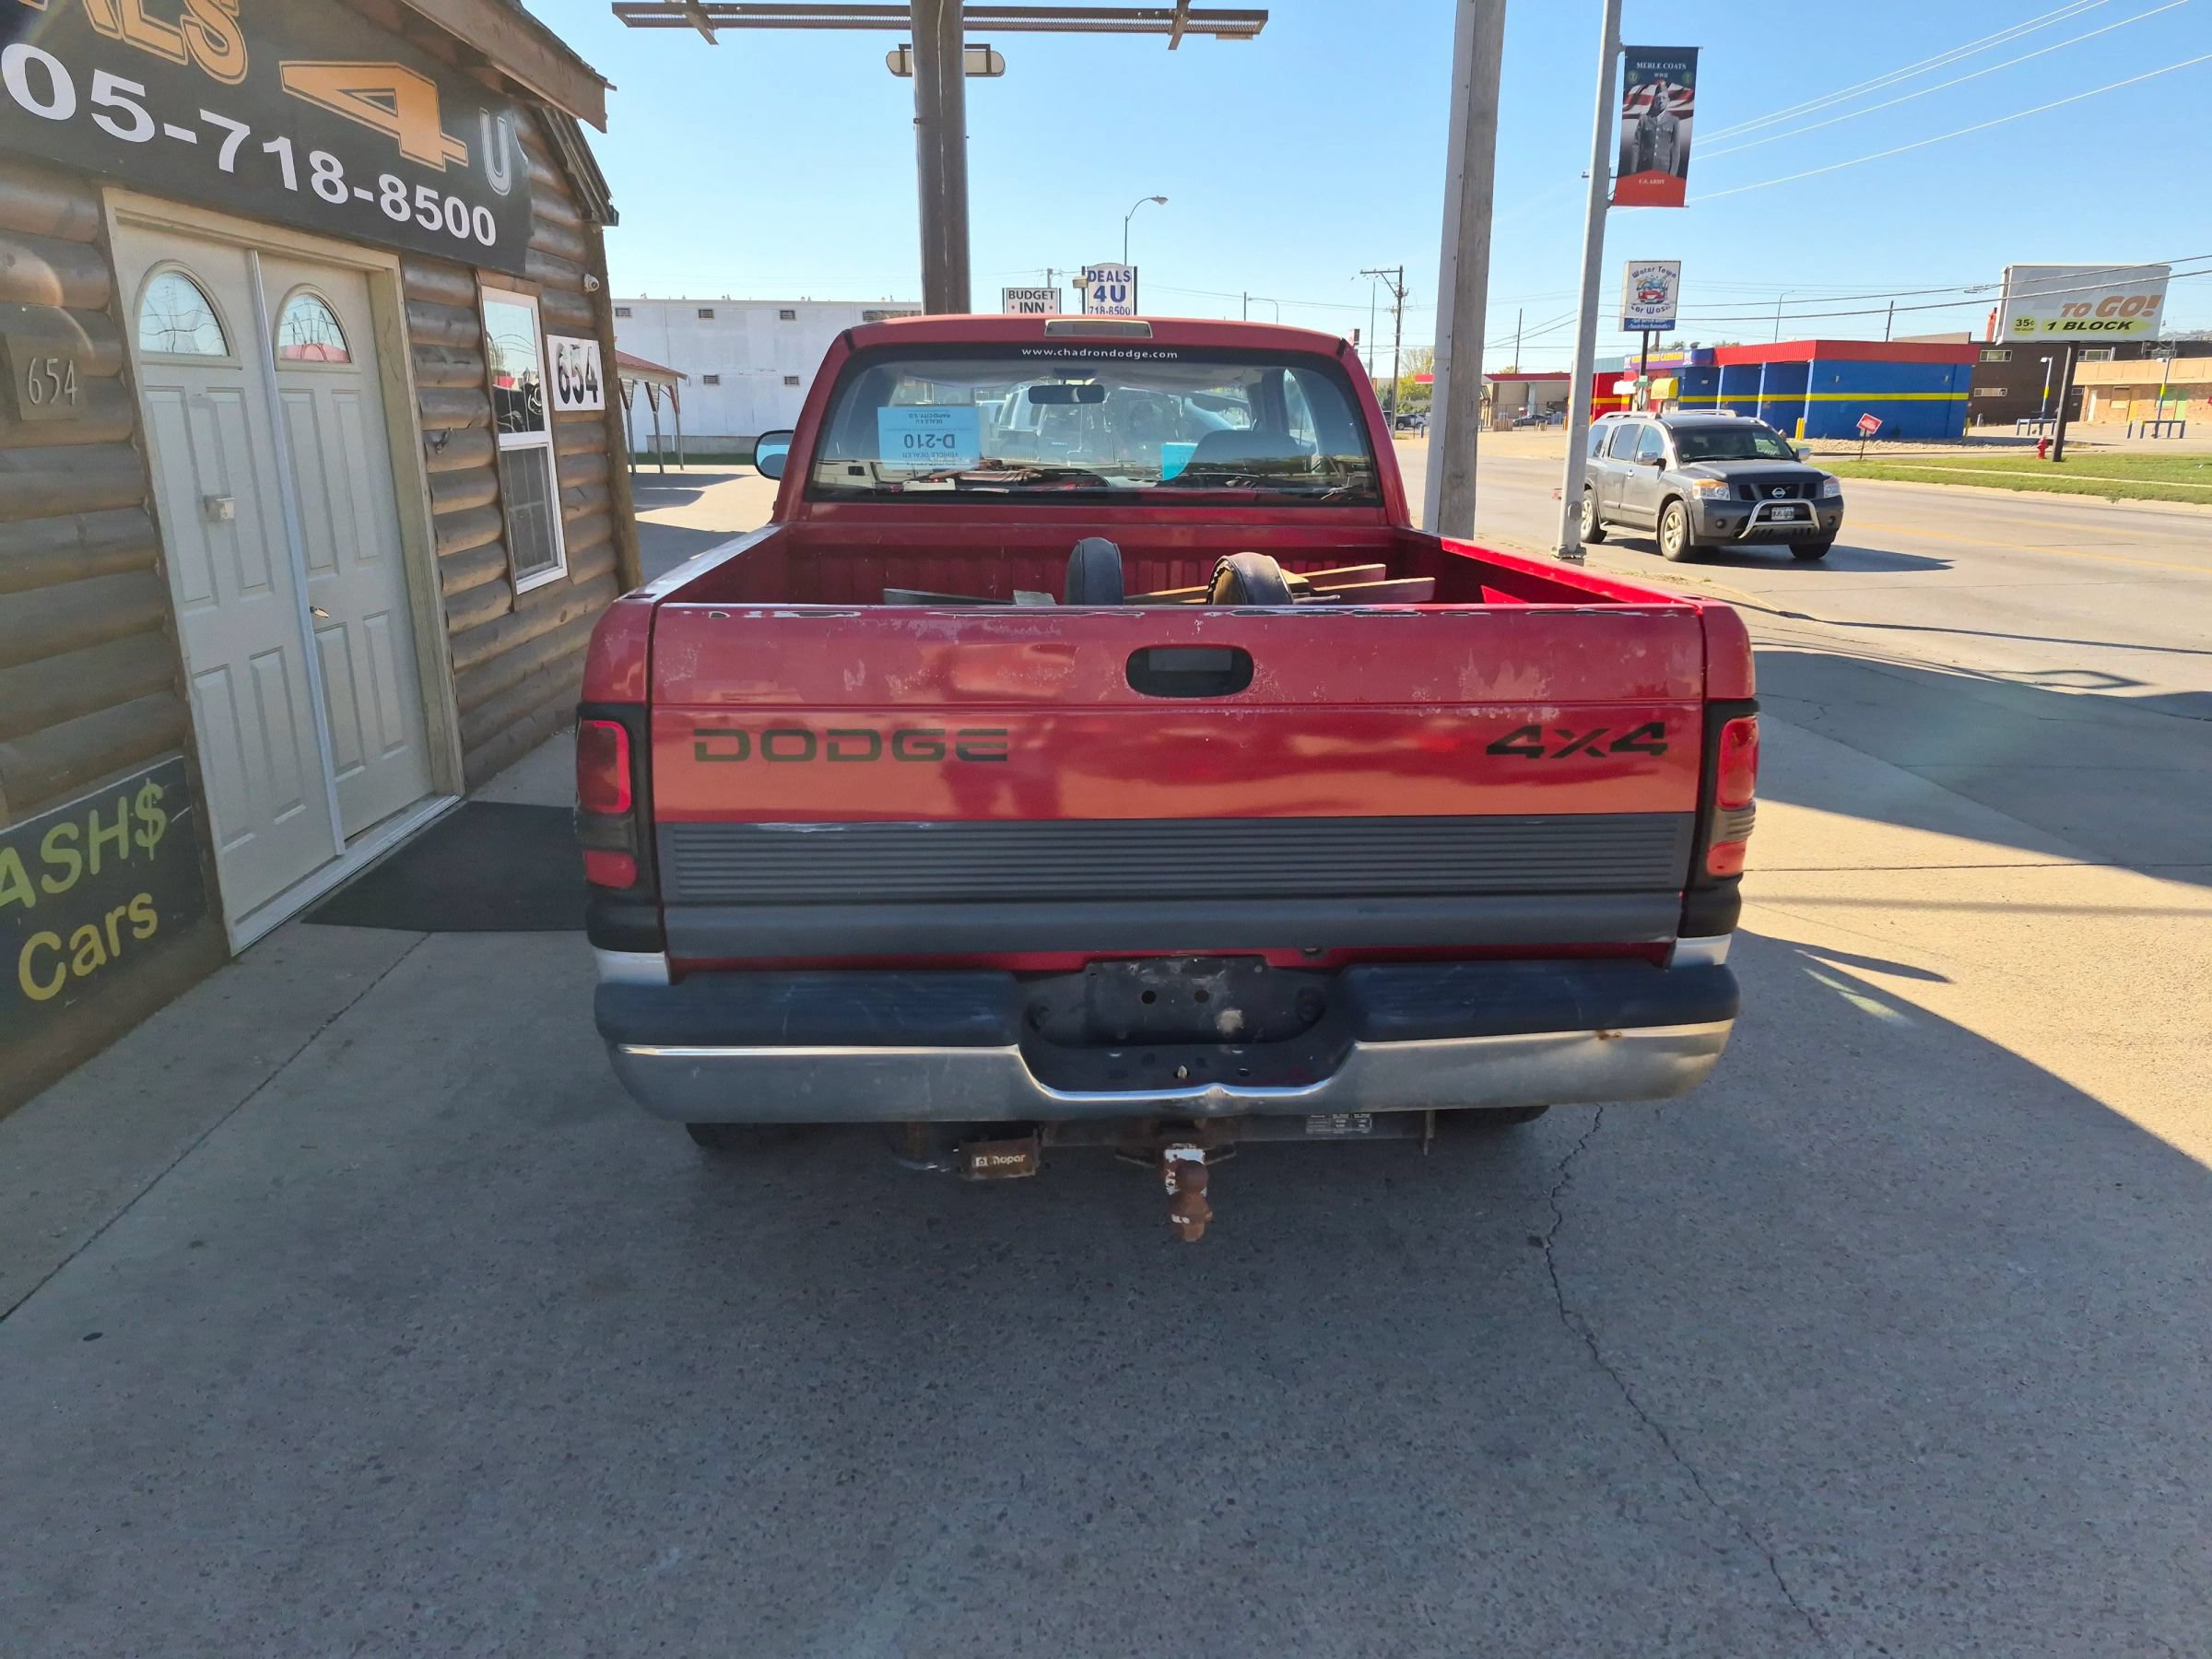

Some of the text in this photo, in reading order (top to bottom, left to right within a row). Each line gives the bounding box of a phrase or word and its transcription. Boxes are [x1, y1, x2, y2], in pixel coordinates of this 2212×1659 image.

[1636, 62, 1687, 71] MERLE COATS
[279, 61, 469, 172] 4
[479, 107, 512, 195] U
[1, 43, 497, 247] 05-718-8500
[1088, 270, 1132, 283] DEALS
[1008, 290, 1055, 300] BUDGET
[1019, 302, 1045, 313] INN
[1089, 306, 1131, 315] 718-8500
[2060, 295, 2162, 318] TO GO!
[2047, 321, 2135, 331] 1 BLOCK
[1021, 347, 1178, 360] www.chadrondodge.com
[555, 343, 598, 404] 654
[29, 357, 77, 406] 654
[904, 434, 955, 449] D-210
[694, 728, 1008, 762] DODGE
[18, 892, 159, 1001] Cars
